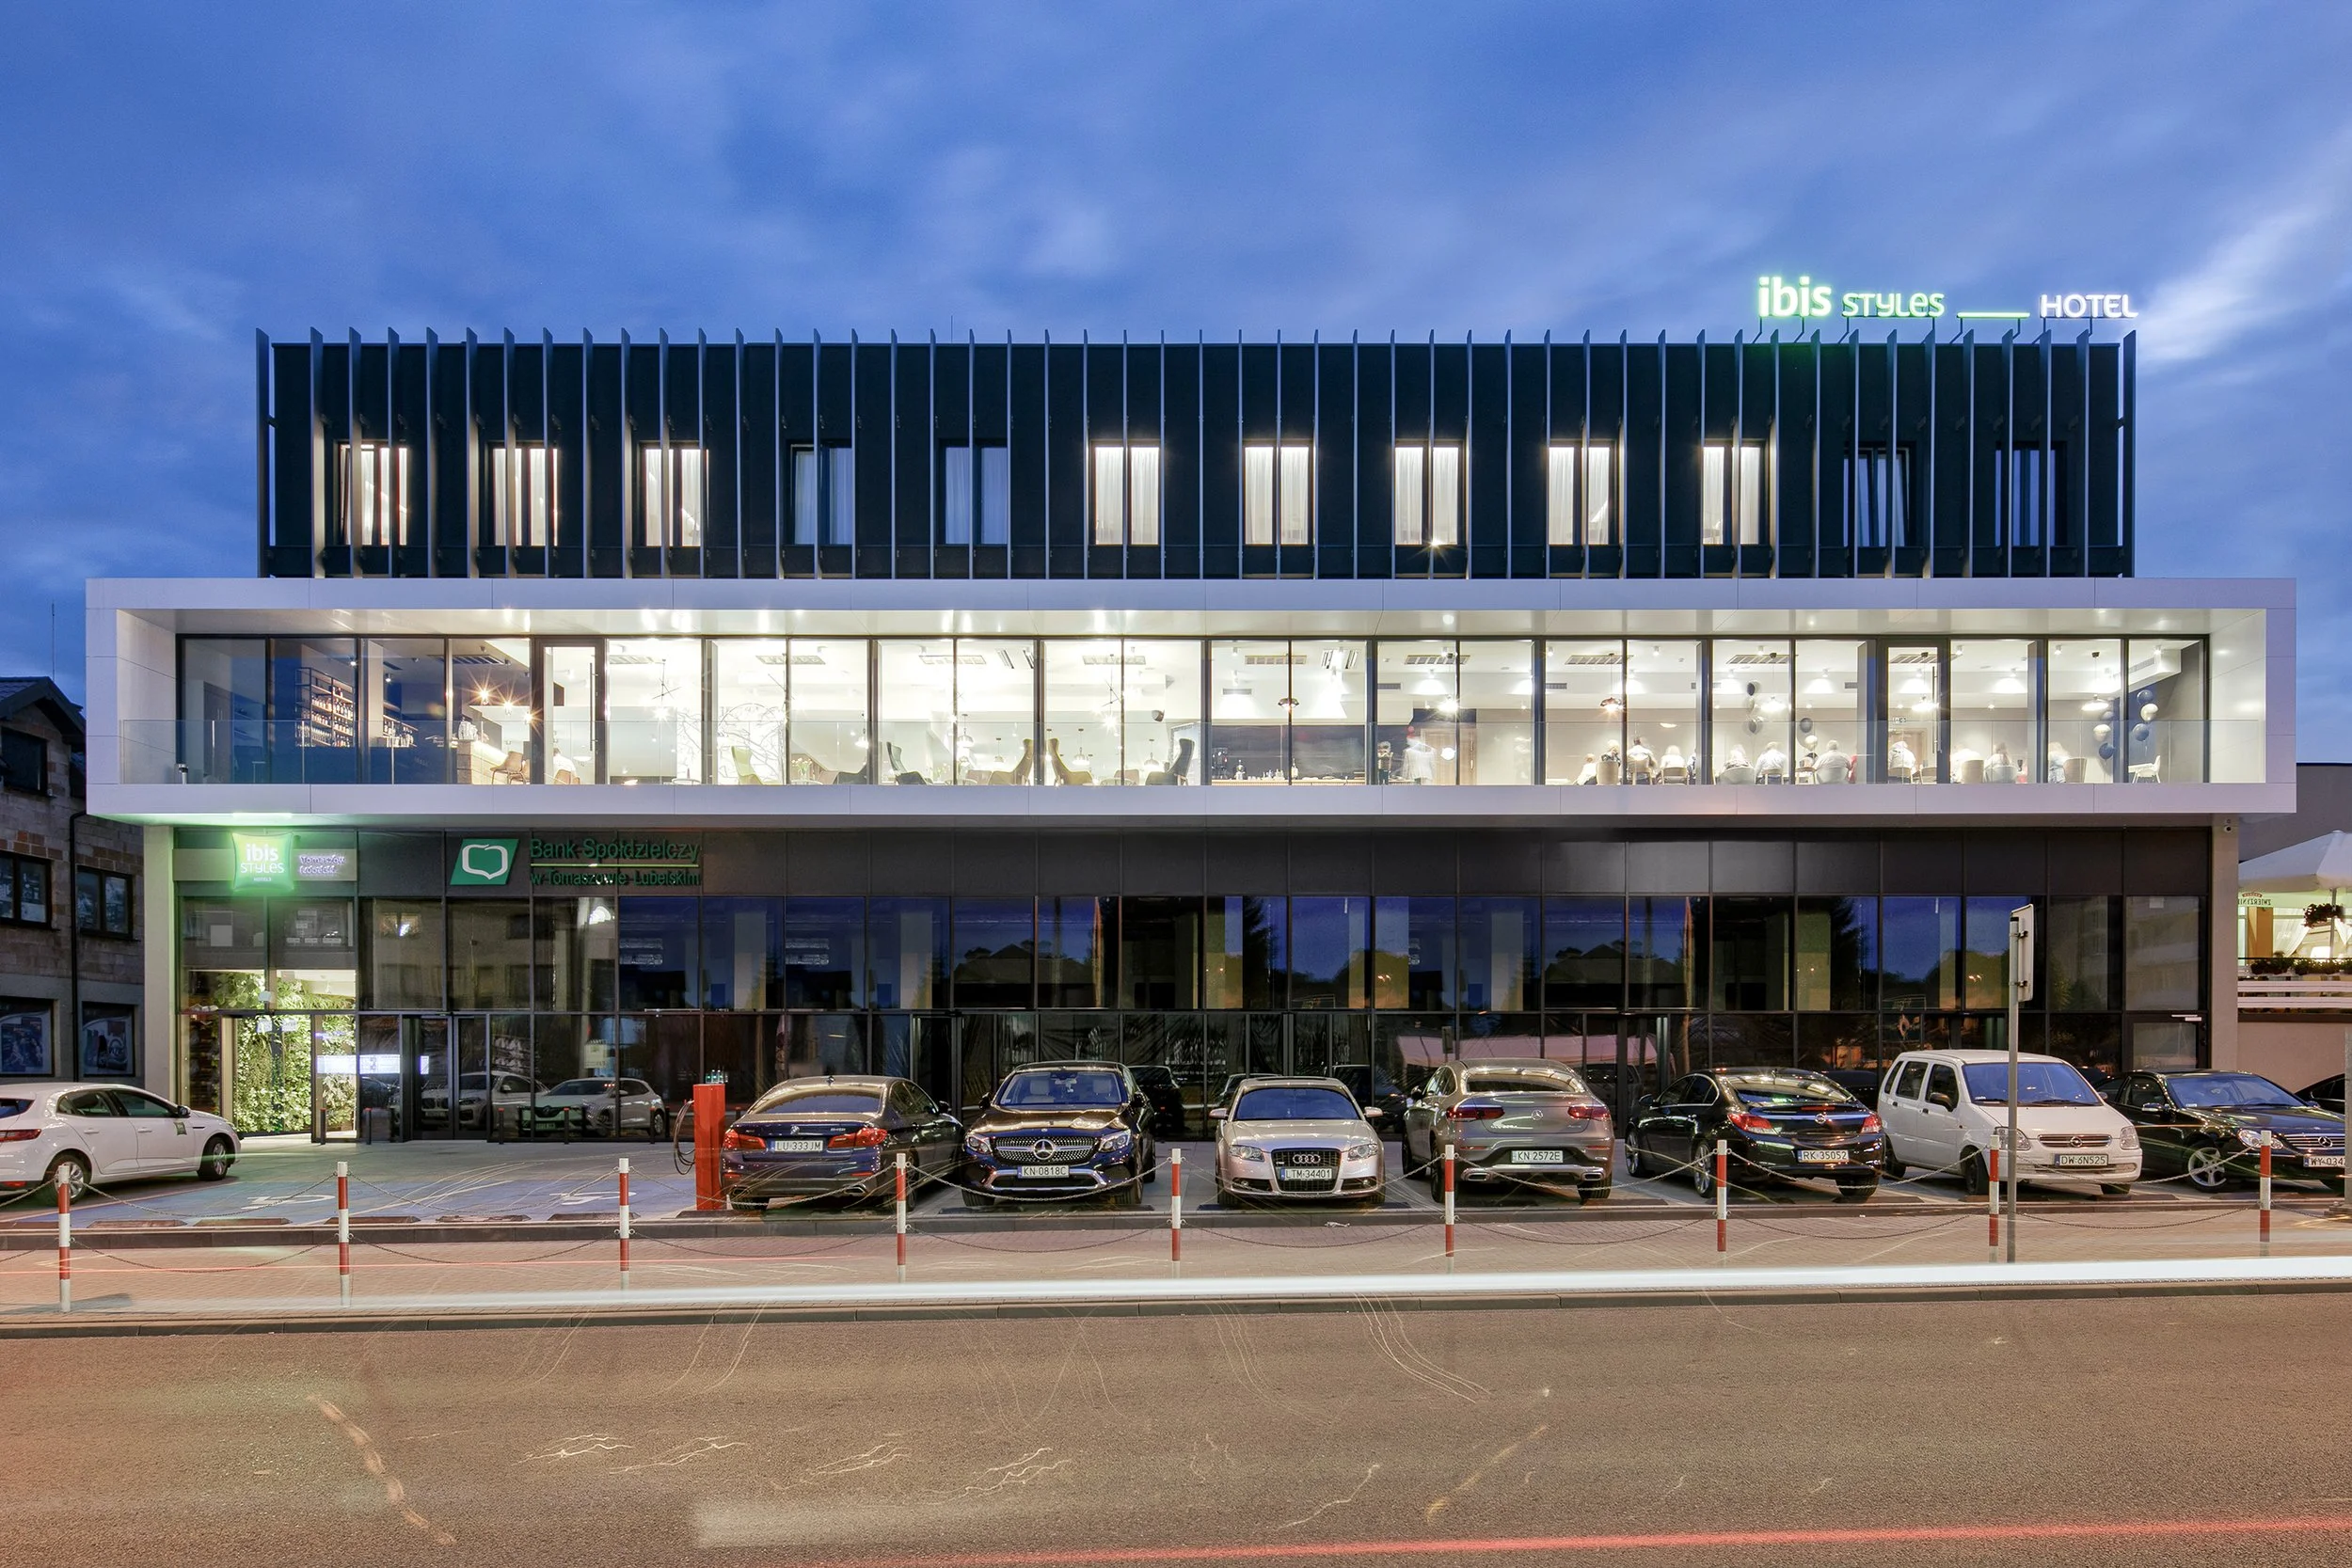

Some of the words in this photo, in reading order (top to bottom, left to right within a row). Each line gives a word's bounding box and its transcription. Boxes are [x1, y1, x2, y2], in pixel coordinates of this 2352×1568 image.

[1758, 276, 1833, 318] ibis
[2040, 293, 2139, 319] HOTEL
[246, 843, 279, 862] ibis
[530, 838, 578, 859] Bank
[582, 836, 699, 863] Spółdzielczy
[530, 872, 543, 885] w
[546, 869, 627, 886] Tomaszowie
[633, 869, 700, 886] Lubelskim
[1518, 1151, 1531, 1161] KN
[1533, 1151, 1561, 1161] 2572E
[1803, 1150, 1817, 1160] RK
[1819, 1150, 1847, 1160] 35052
[2060, 1156, 2075, 1164] DW
[1023, 1166, 1036, 1176] KN
[1038, 1166, 1067, 1176] 0818C
[1285, 1169, 1303, 1179] LTM
[1305, 1169, 1330, 1179] 34401
